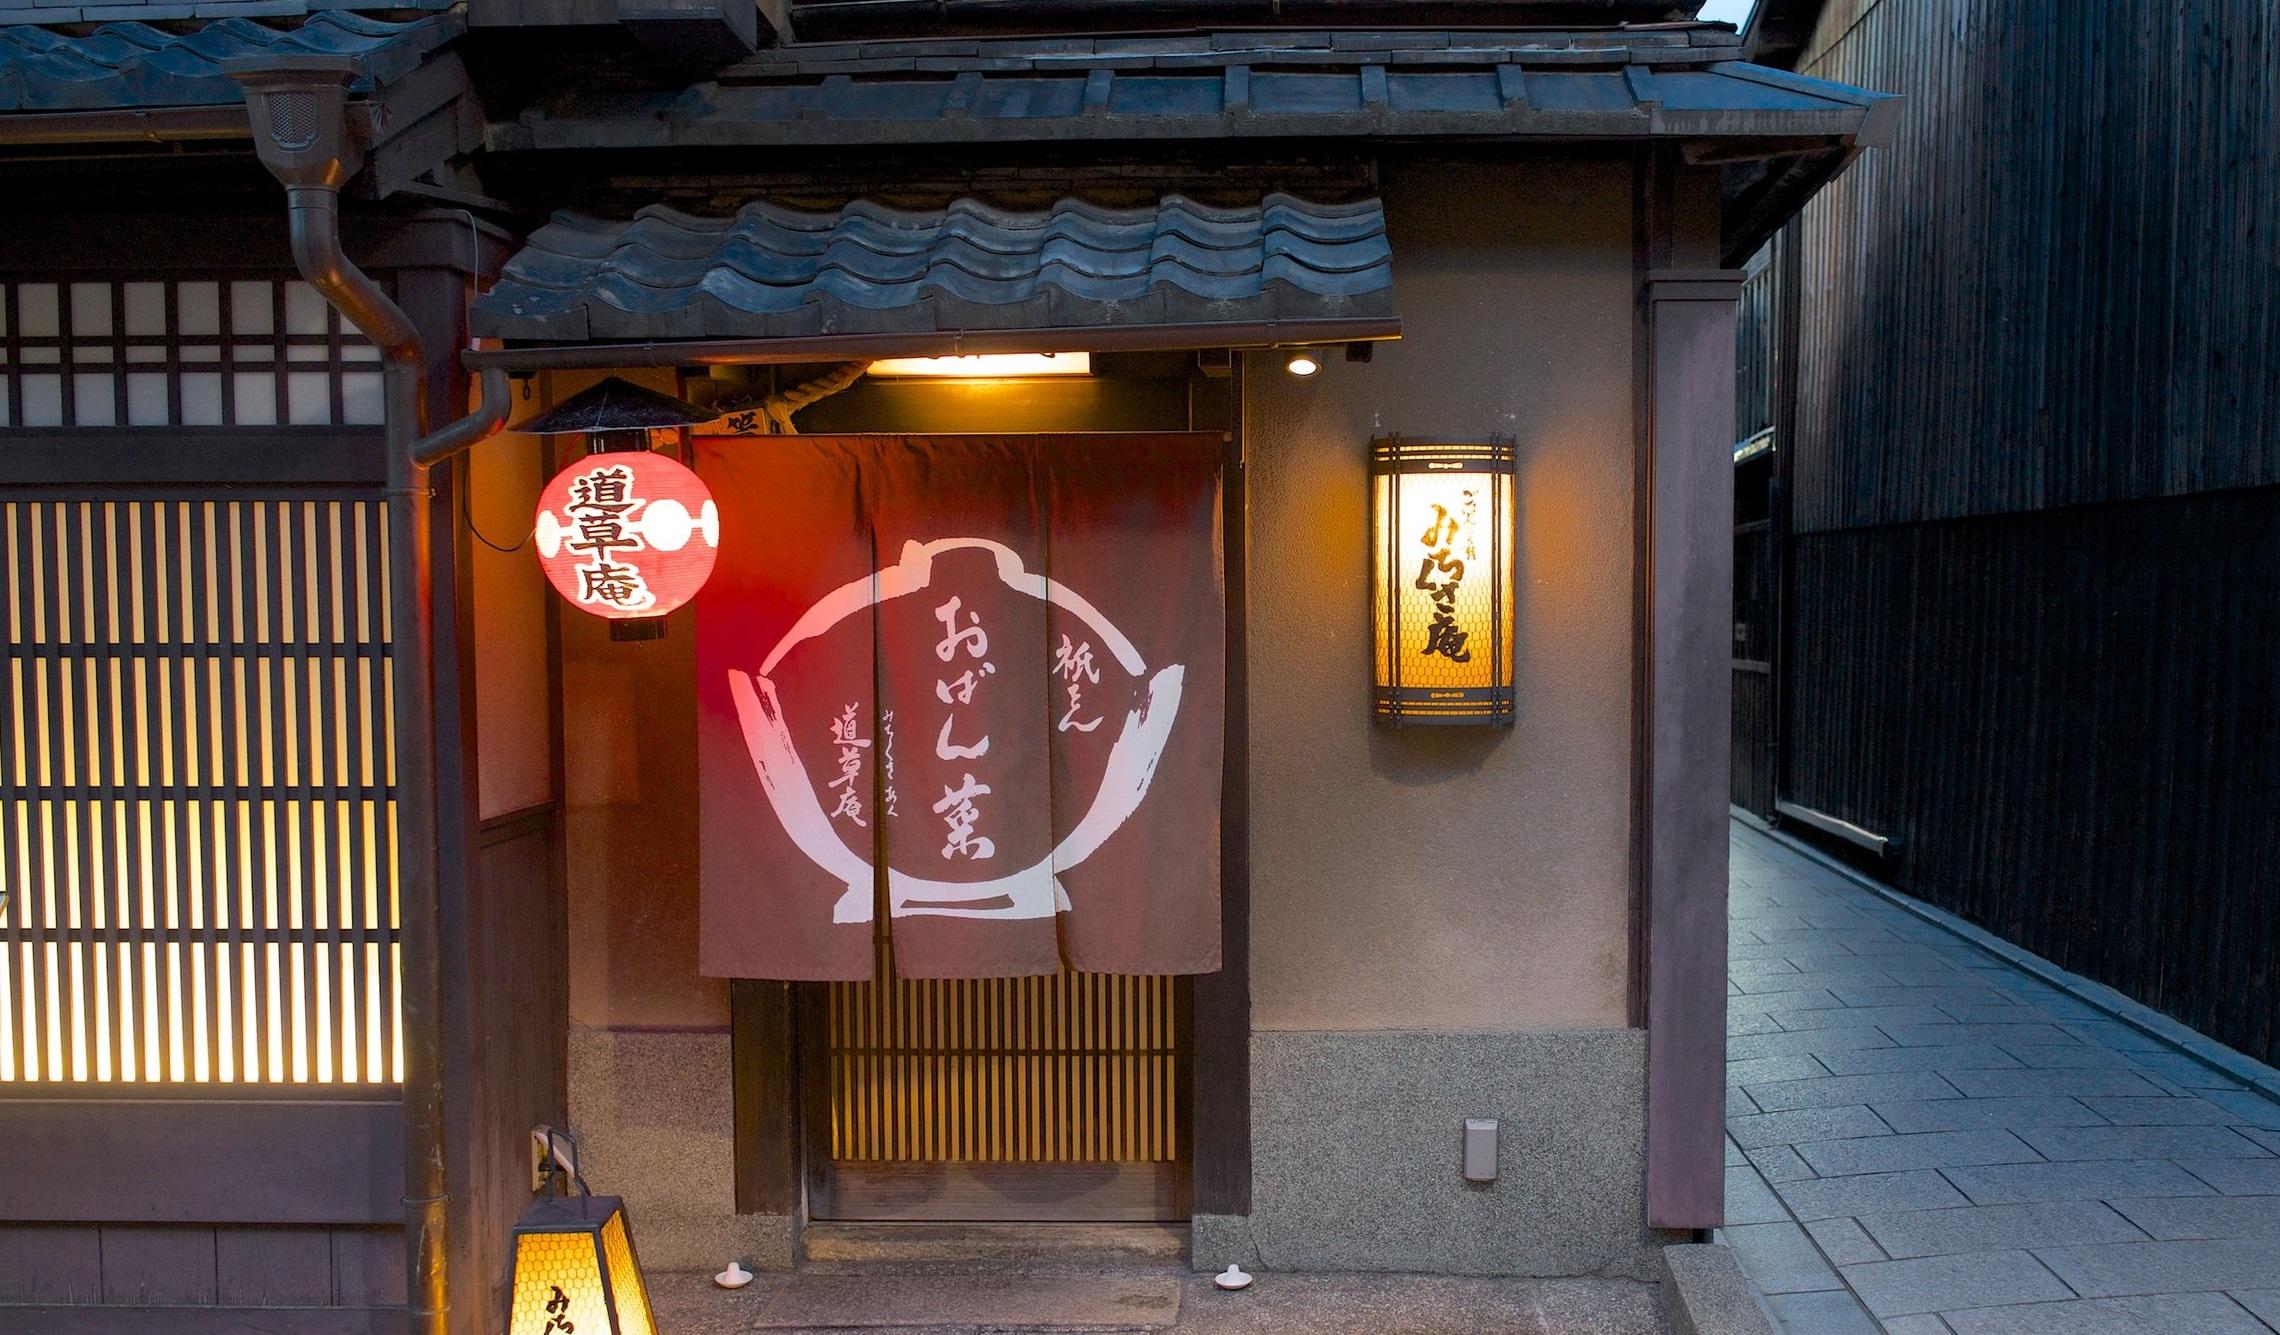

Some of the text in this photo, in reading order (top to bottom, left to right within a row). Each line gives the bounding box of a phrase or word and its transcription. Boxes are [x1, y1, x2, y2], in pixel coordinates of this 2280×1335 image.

[569, 468, 646, 607] 道草庵
[828, 701, 872, 827] 道草庵
[932, 595, 996, 860] おばん菜
